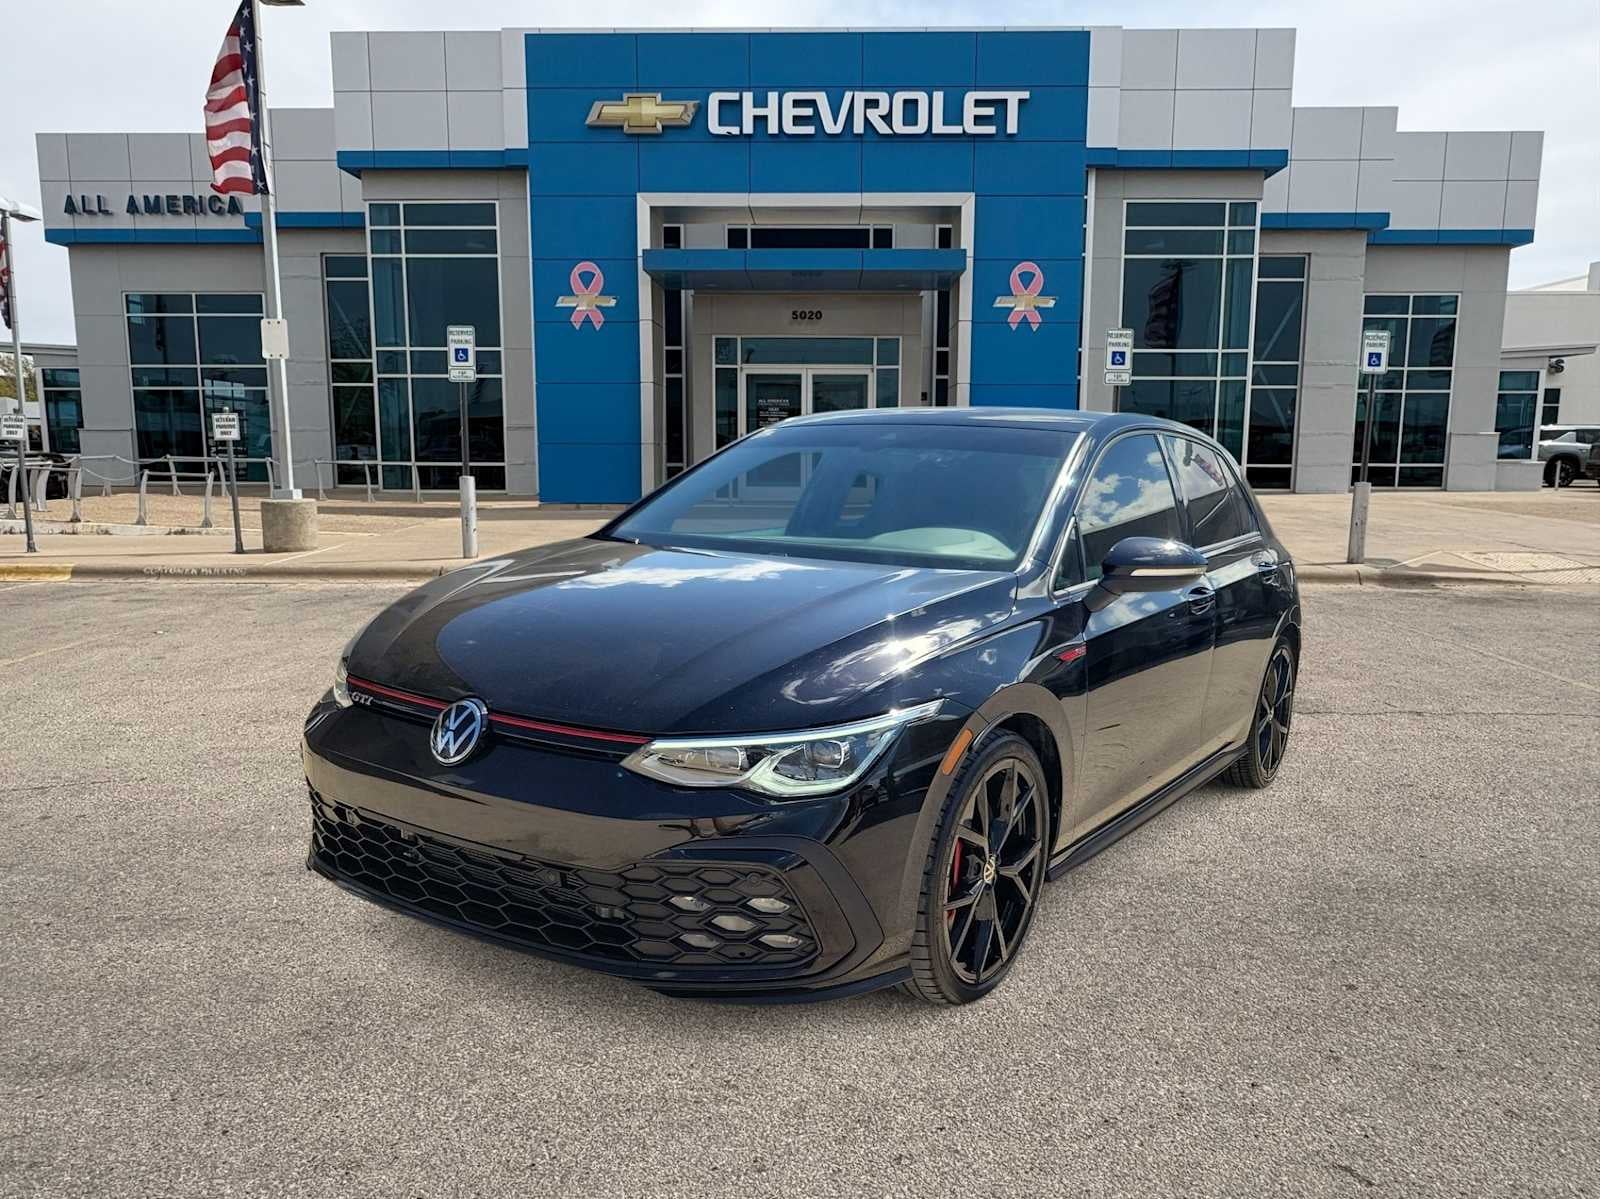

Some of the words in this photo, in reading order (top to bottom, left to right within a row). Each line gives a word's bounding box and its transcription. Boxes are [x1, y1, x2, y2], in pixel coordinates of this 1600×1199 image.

[707, 91, 1030, 135] CHEVROLET
[64, 195, 112, 215] ALL
[791, 310, 823, 320] 5020
[351, 691, 375, 706] GTI
